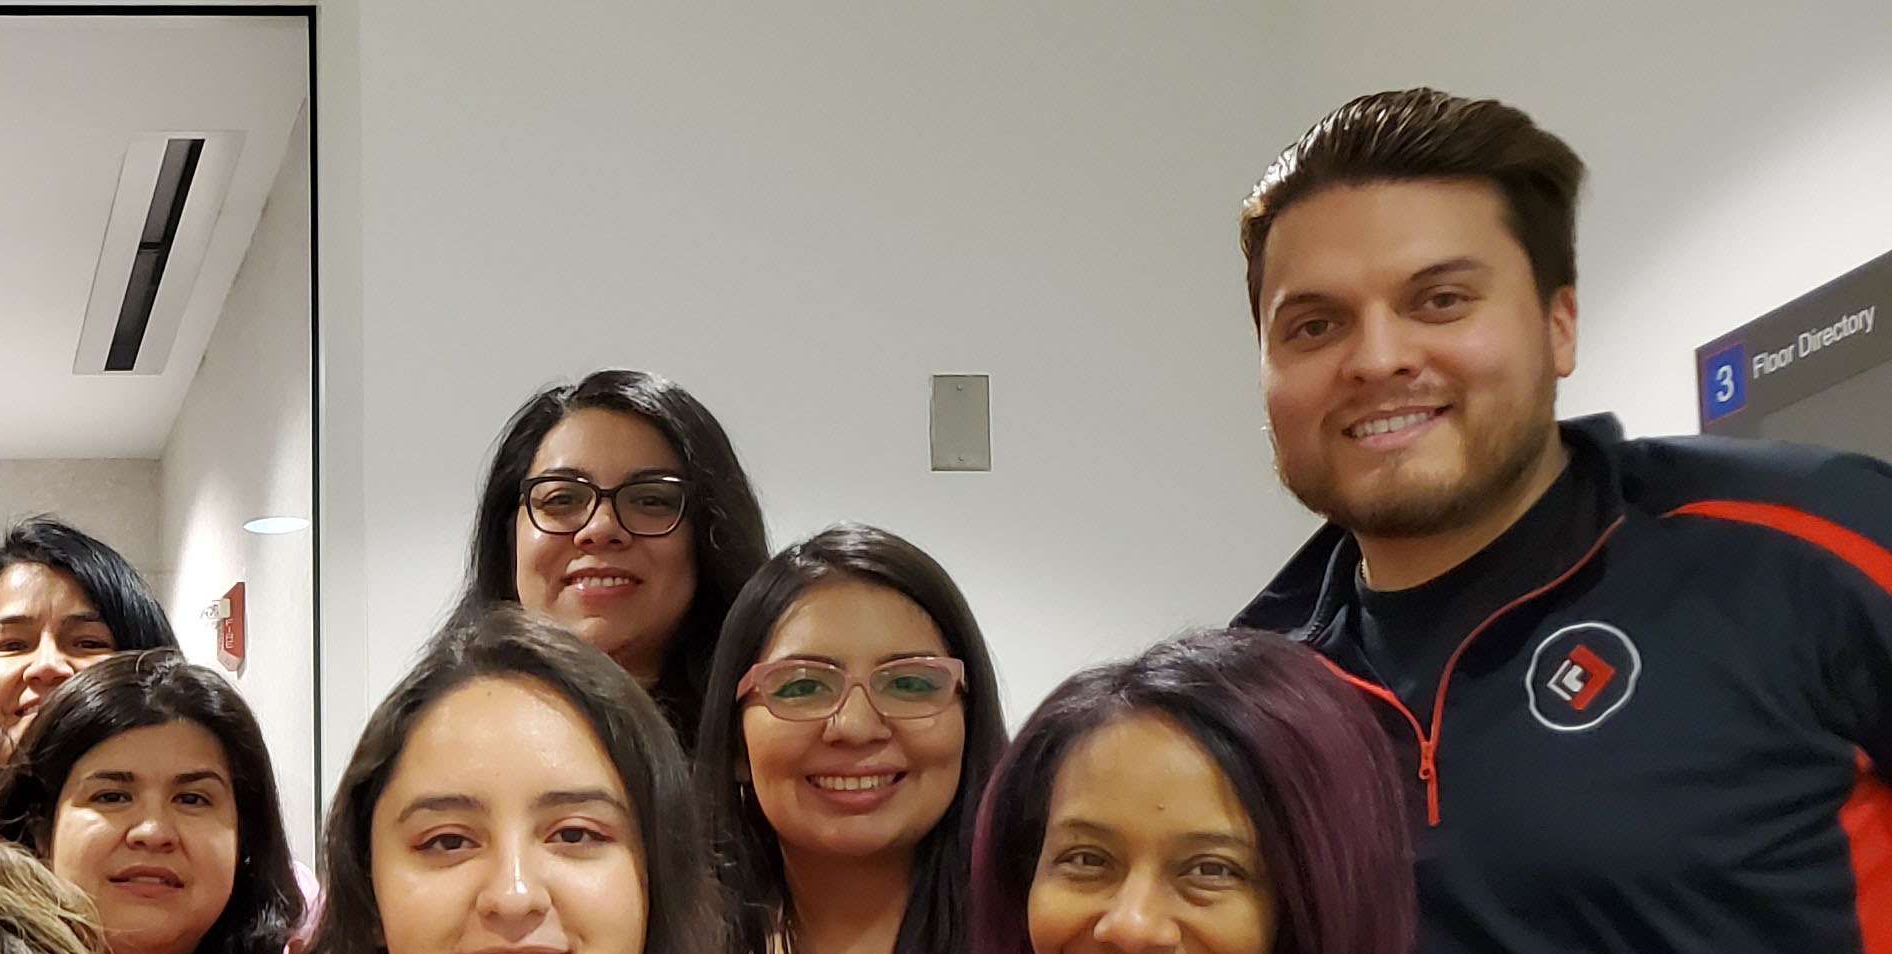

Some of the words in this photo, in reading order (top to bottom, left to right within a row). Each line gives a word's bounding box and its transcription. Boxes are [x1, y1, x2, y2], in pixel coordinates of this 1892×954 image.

[1716, 365, 1735, 402] 3
[1753, 344, 1795, 379] Floor
[1798, 306, 1875, 358] Directory
